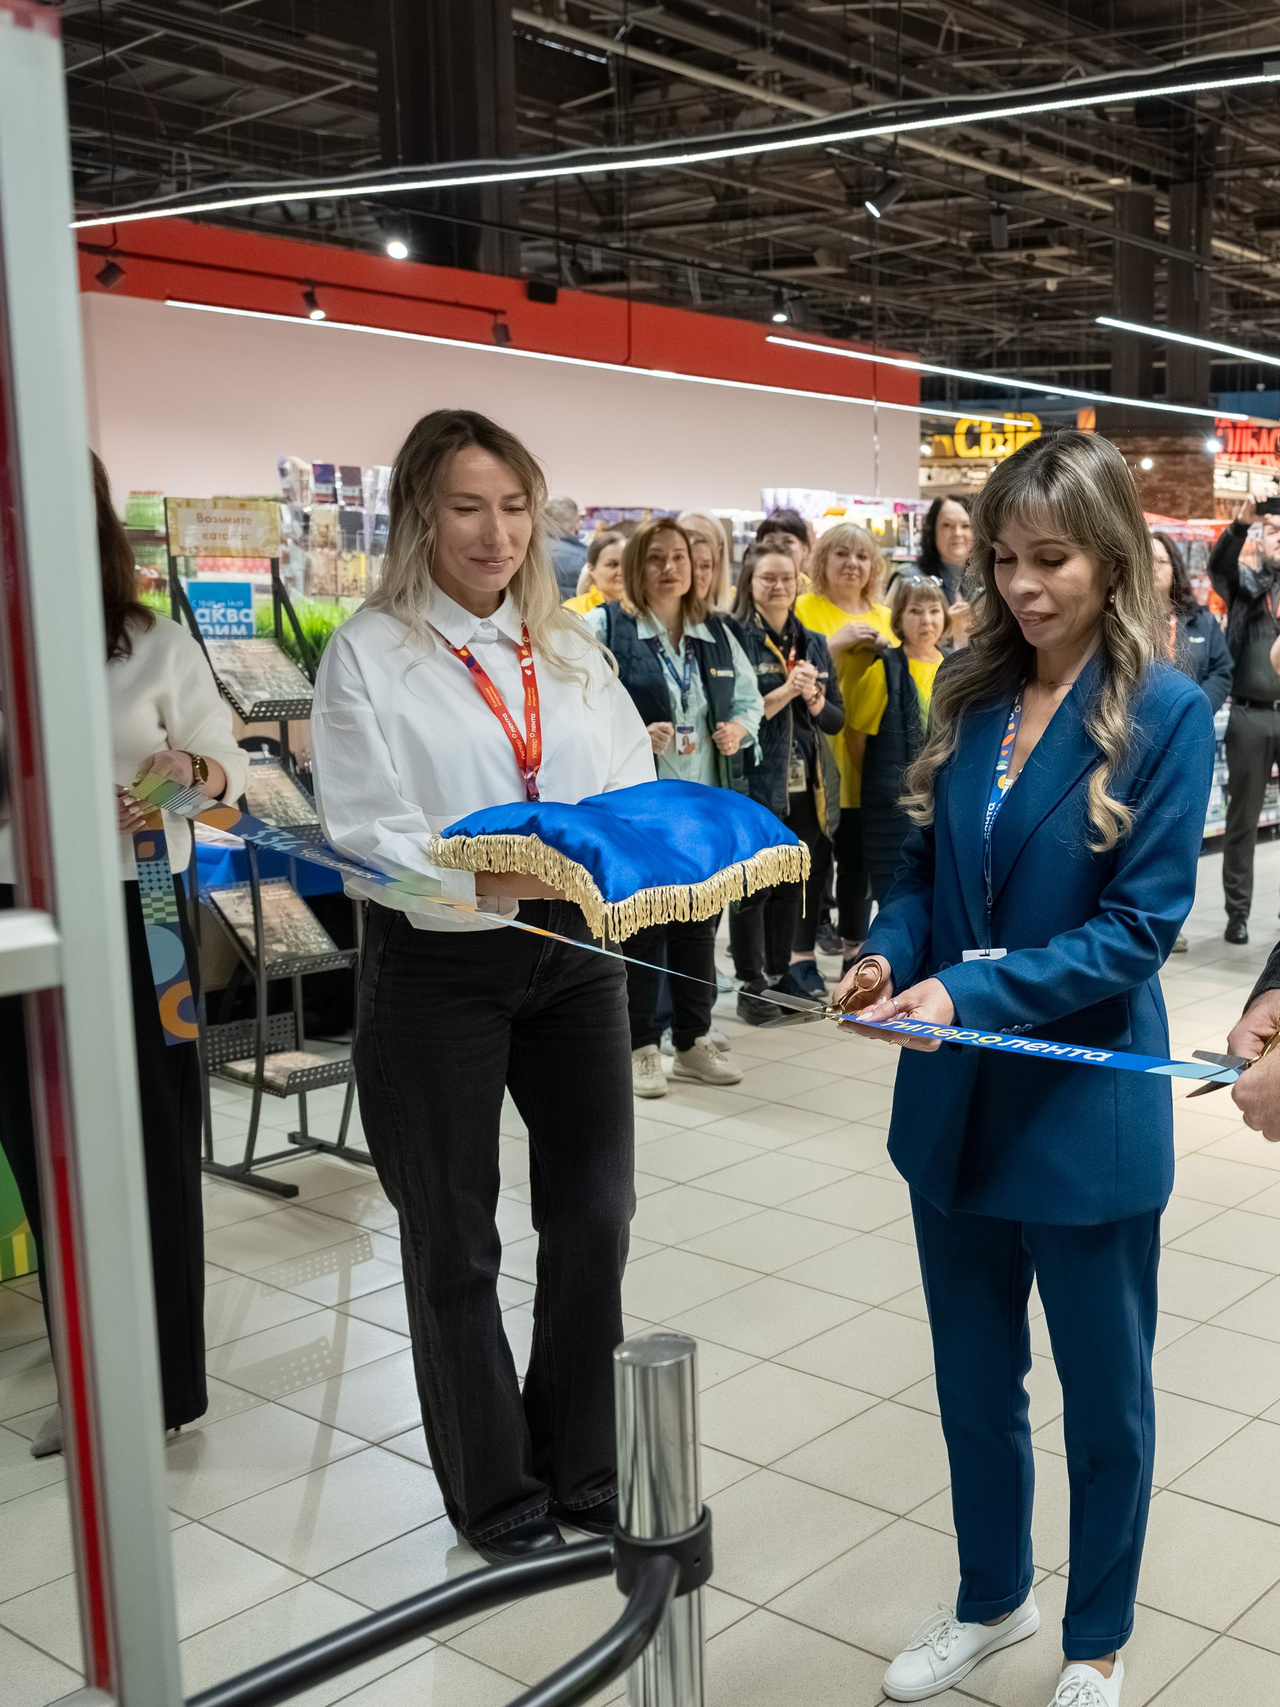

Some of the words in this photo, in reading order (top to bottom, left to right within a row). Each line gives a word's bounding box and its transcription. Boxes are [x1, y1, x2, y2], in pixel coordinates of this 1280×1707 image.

[196, 512, 253, 525] Возьмите
[202, 533, 250, 542] каталог
[194, 608, 254, 624] аква
[199, 624, 247, 637] рим
[999, 1037, 1115, 1062] лента
